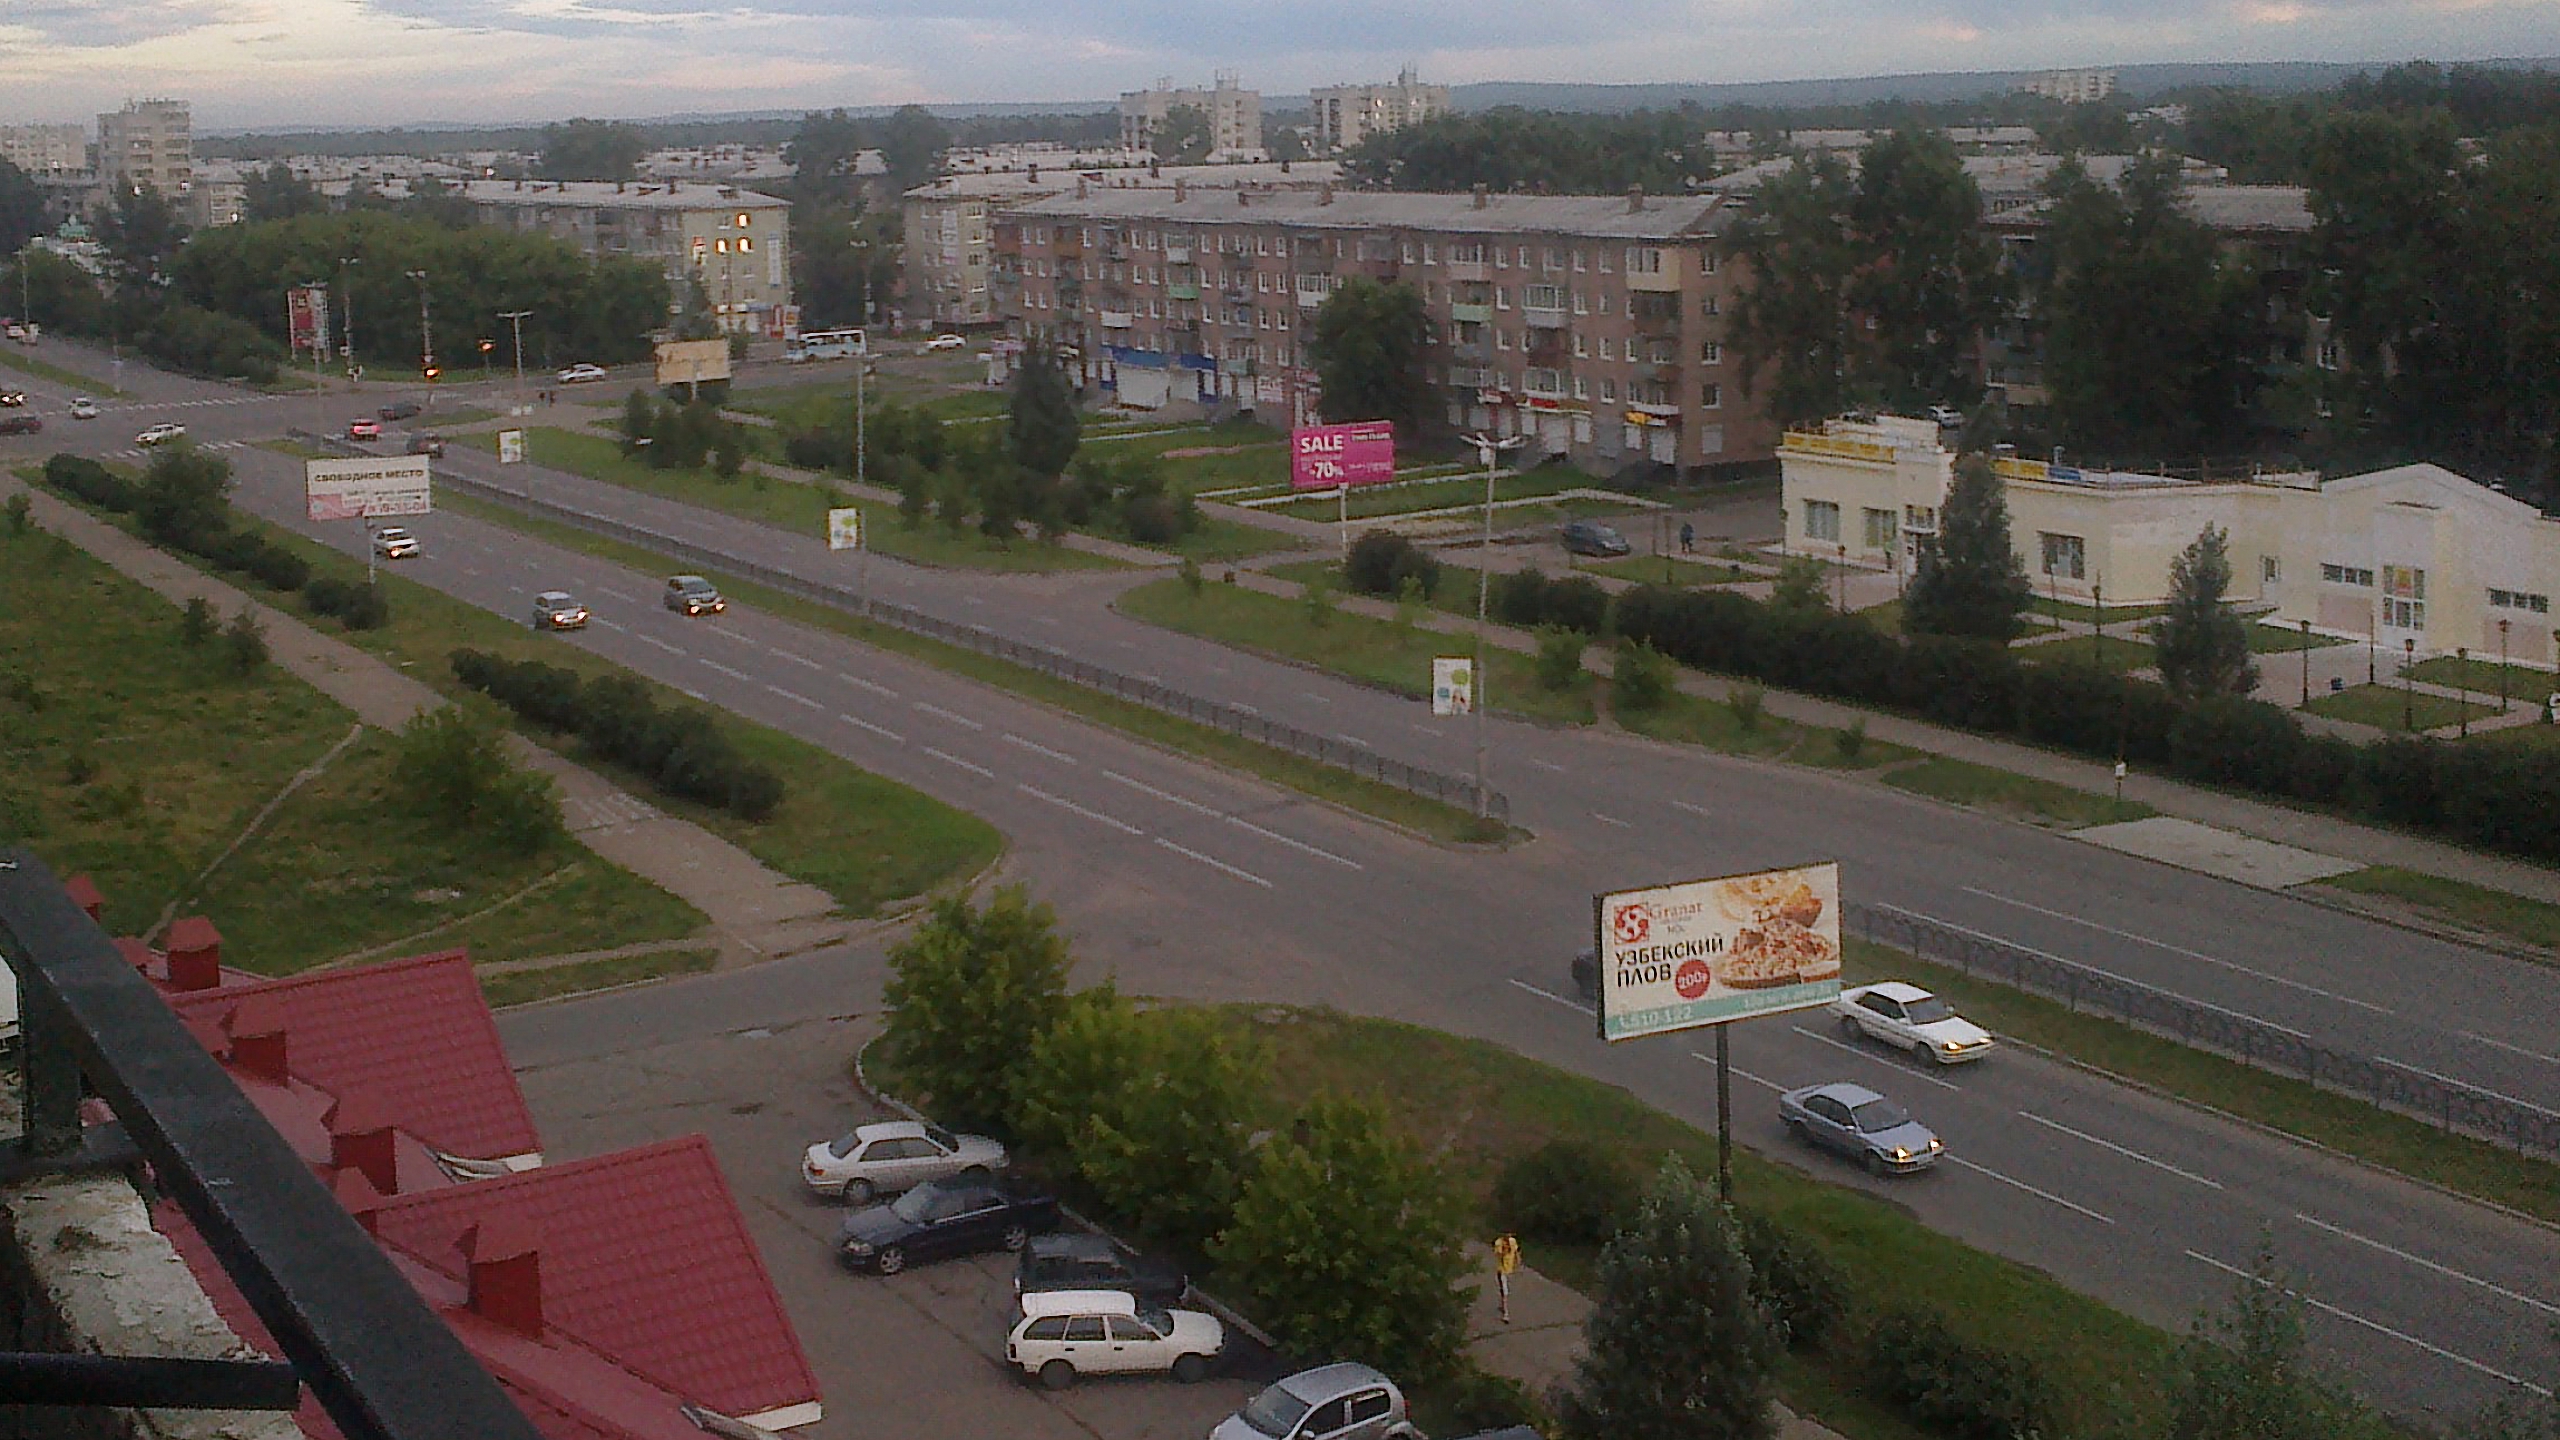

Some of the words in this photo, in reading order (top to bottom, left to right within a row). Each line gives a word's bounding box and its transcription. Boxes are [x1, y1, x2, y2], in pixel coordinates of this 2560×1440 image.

[1300, 434, 1344, 454] SALE
[314, 471, 383, 483] СВОБОДНОЕ
[385, 469, 424, 479] МЕСТО
[1615, 932, 1724, 968] УЗБЕКСКИЙ
[1617, 963, 1672, 988] ПЛОВ
